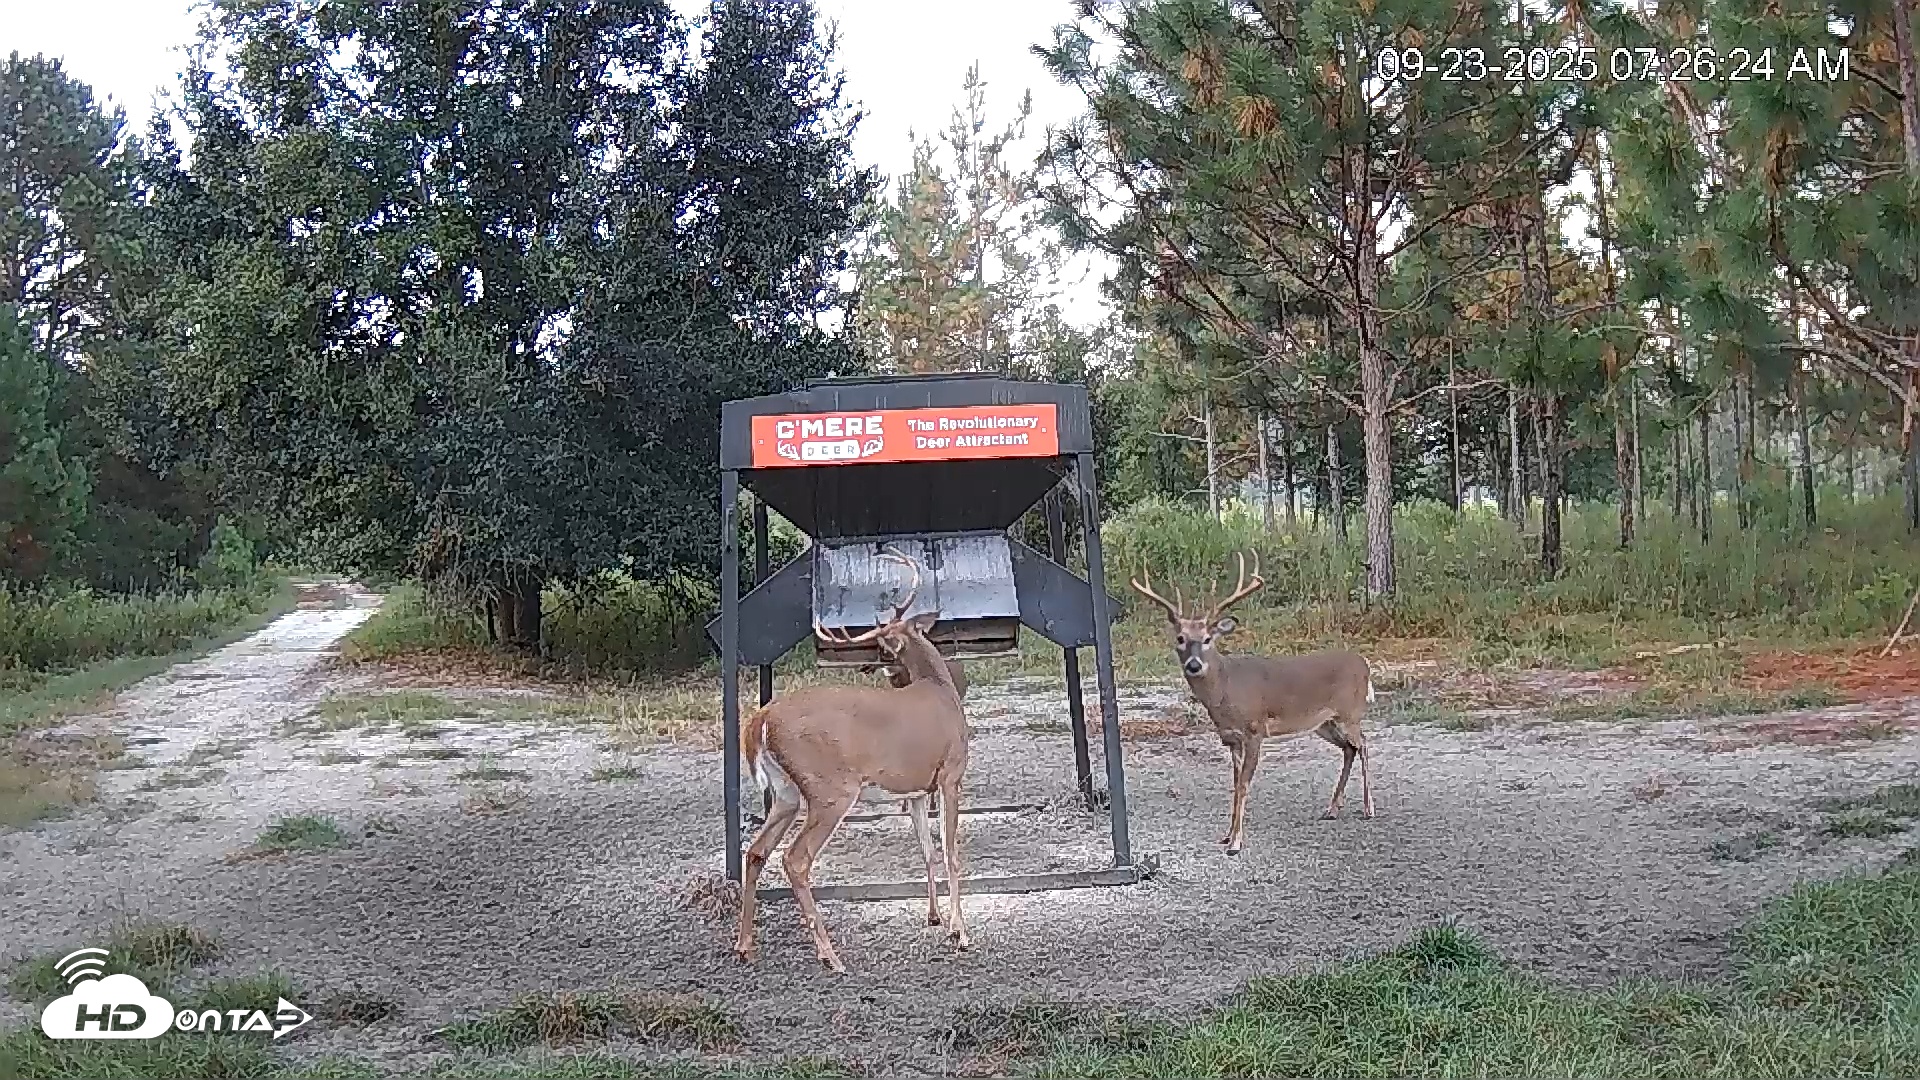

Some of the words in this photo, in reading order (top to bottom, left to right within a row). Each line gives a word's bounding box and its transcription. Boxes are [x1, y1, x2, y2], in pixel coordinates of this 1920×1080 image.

[776, 415, 884, 439] C'MERE
[907, 418, 934, 431] The
[939, 415, 1039, 432] Revolutionary
[916, 436, 950, 449] Deer
[955, 433, 1029, 447] Attractant
[806, 445, 856, 458] DEER
